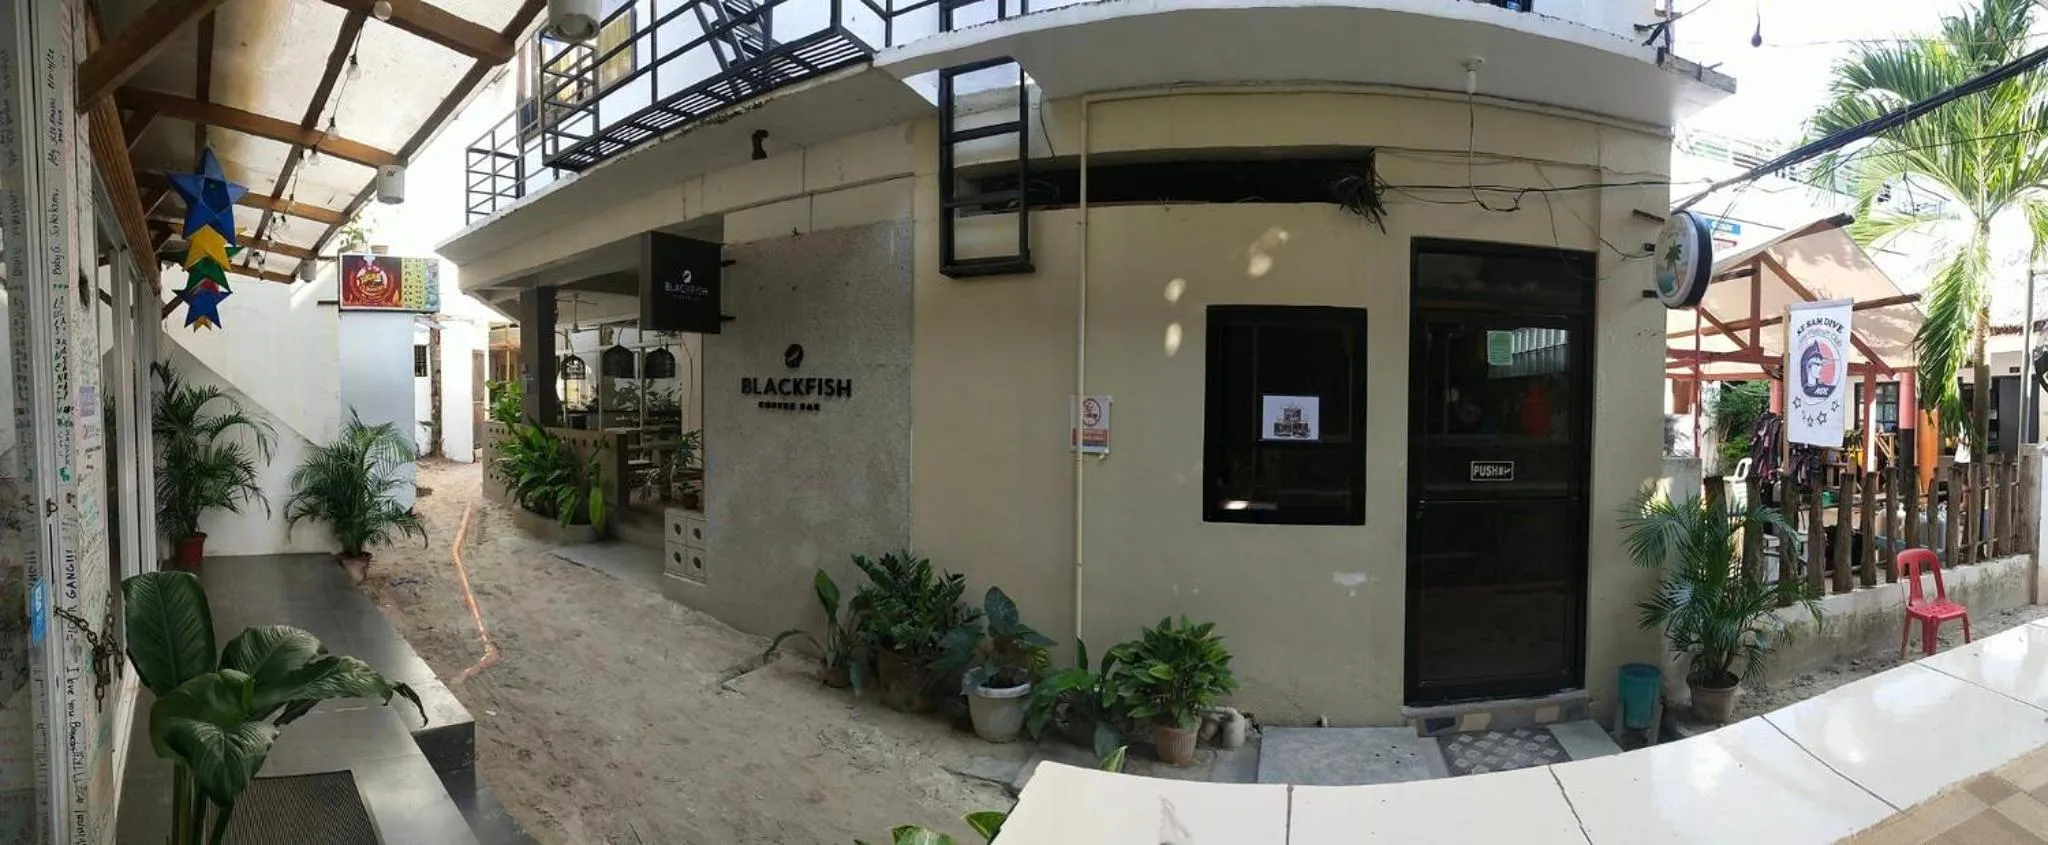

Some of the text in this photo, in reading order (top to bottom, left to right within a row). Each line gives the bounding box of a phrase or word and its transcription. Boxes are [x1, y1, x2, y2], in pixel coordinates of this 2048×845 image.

[664, 281, 709, 297] BLACKFISH
[1823, 317, 1845, 333] DIVE
[741, 377, 852, 397] BLACKFISH
[758, 401, 821, 411] COFFEE BAR
[1474, 464, 1499, 477] PUSH
